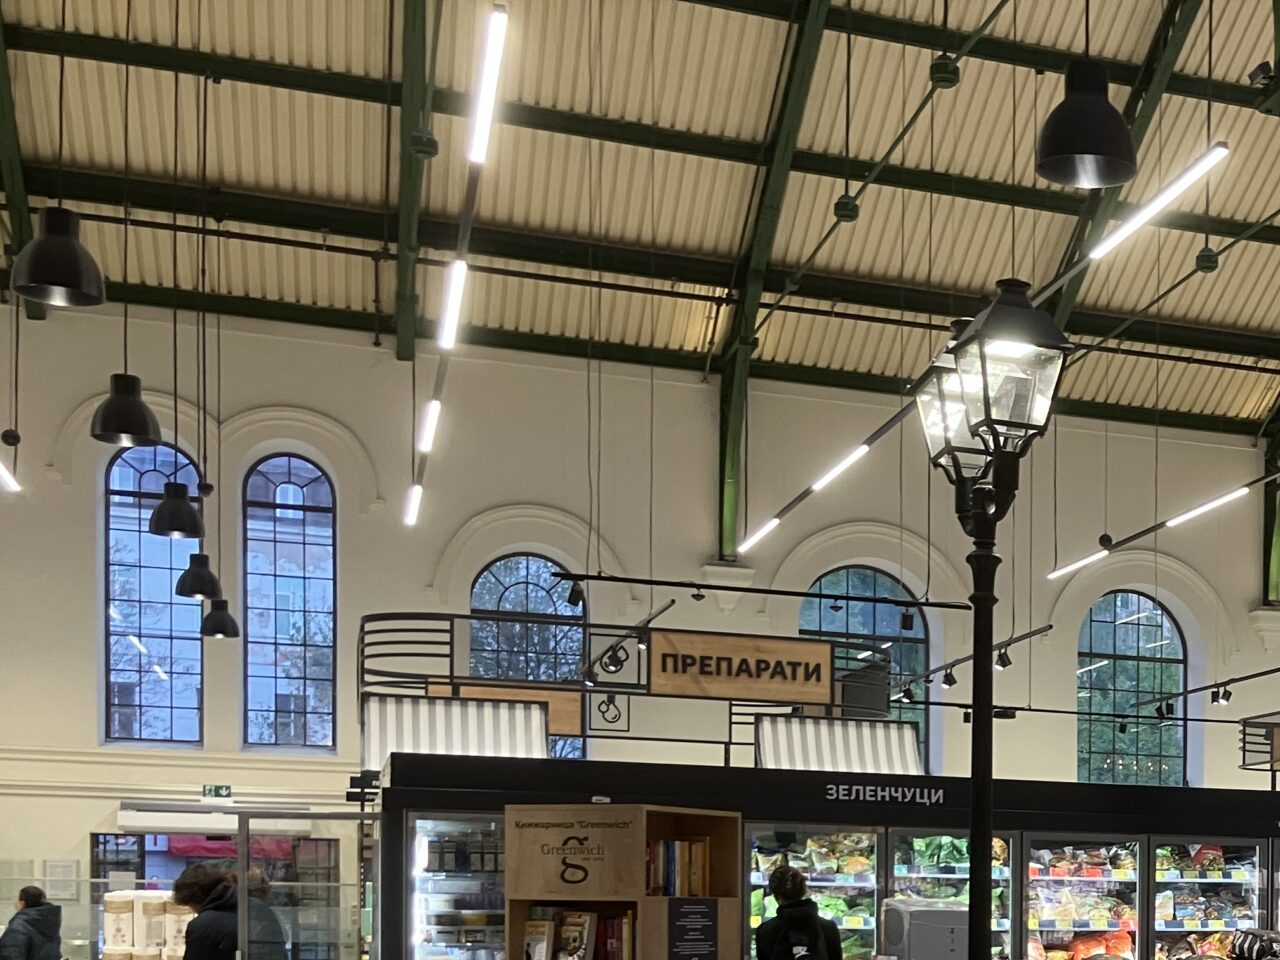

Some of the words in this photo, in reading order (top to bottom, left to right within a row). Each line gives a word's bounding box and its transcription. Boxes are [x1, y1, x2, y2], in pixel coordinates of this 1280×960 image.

[661, 652, 822, 683] ПРЕПАРАТИ
[826, 784, 944, 806] ЗЕЛЕНЧУЦИ
[541, 843, 605, 856] Greenwich
